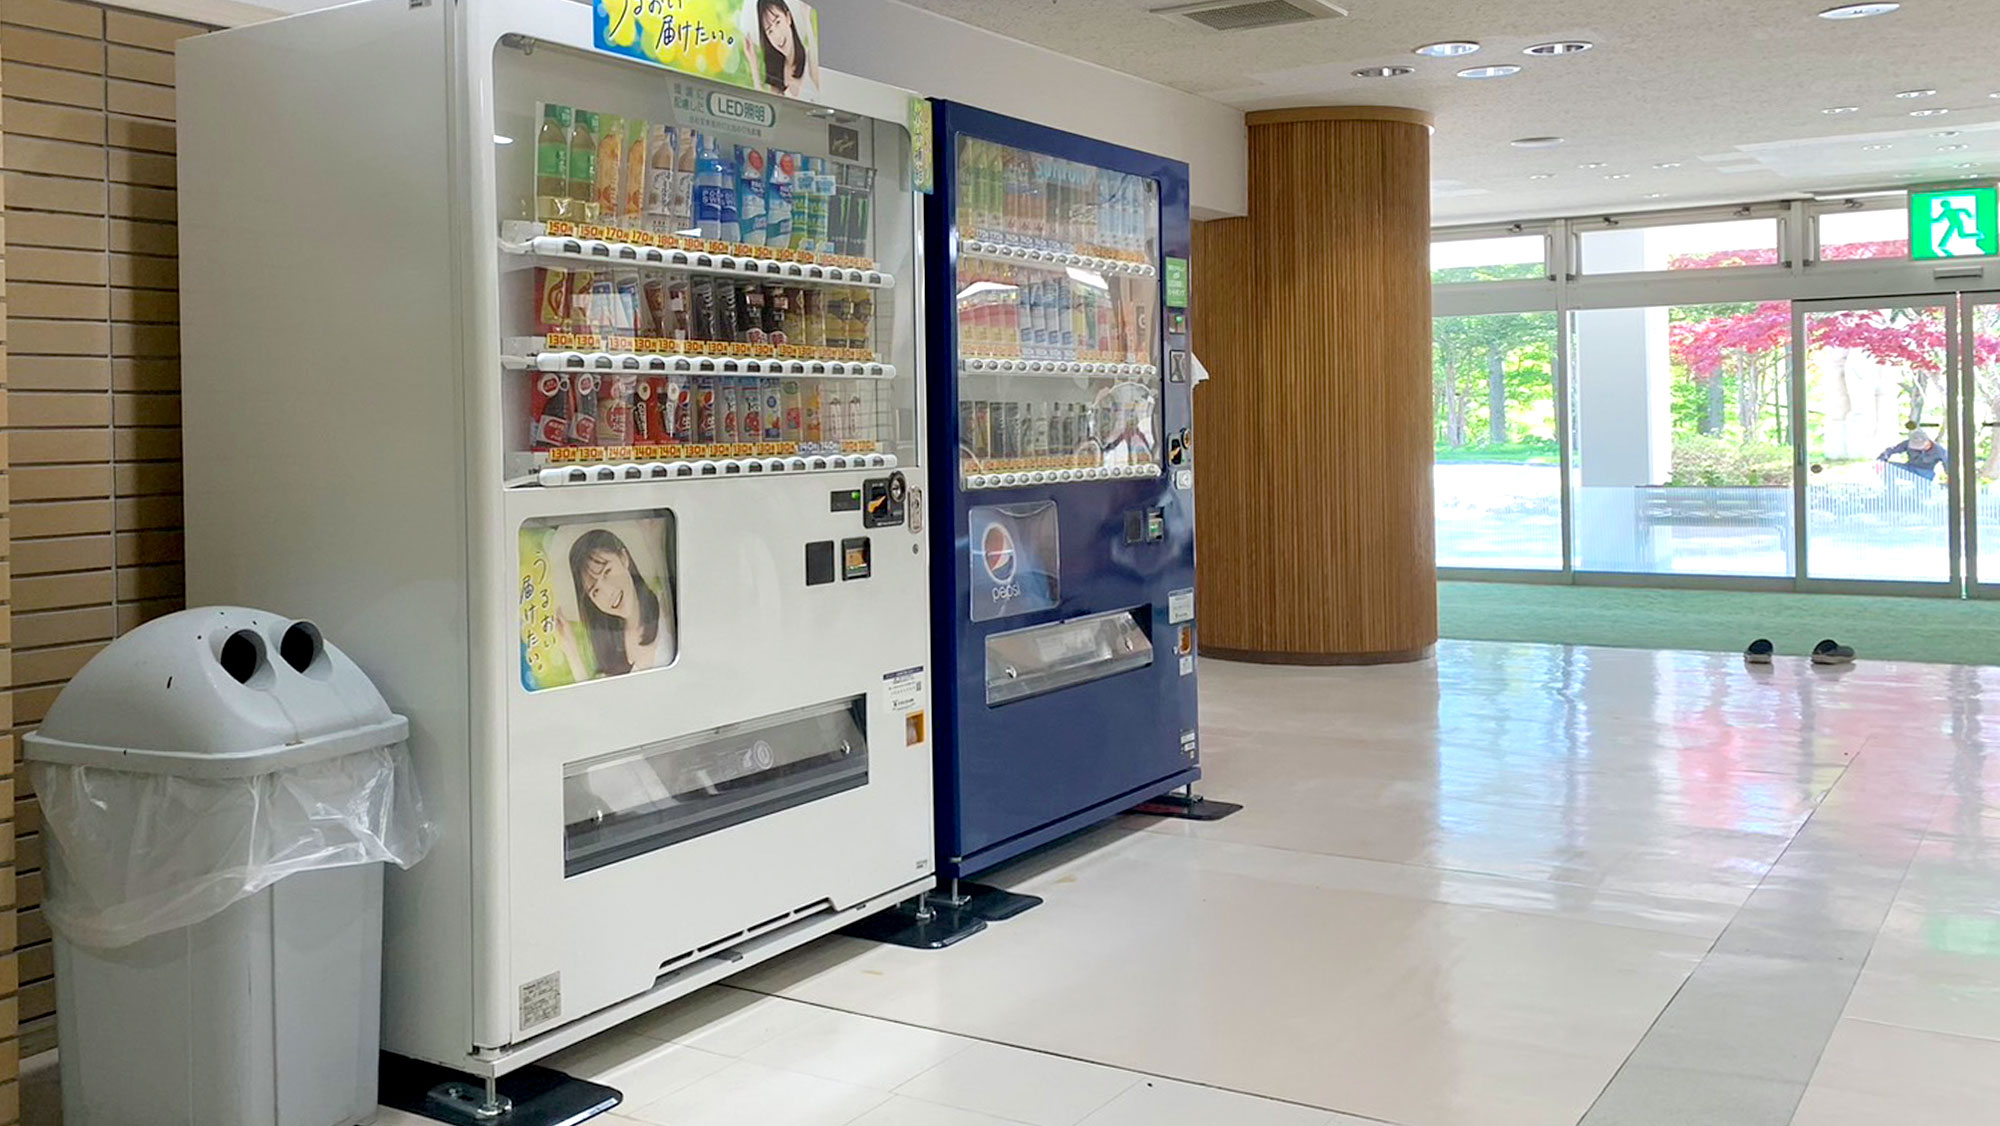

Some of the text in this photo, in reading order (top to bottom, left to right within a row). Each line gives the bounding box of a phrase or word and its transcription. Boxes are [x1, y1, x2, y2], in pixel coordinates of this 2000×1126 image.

[656, 15, 734, 52] 届けたい。
[533, 551, 556, 648] うるおい
[991, 582, 1020, 603] pepsi
